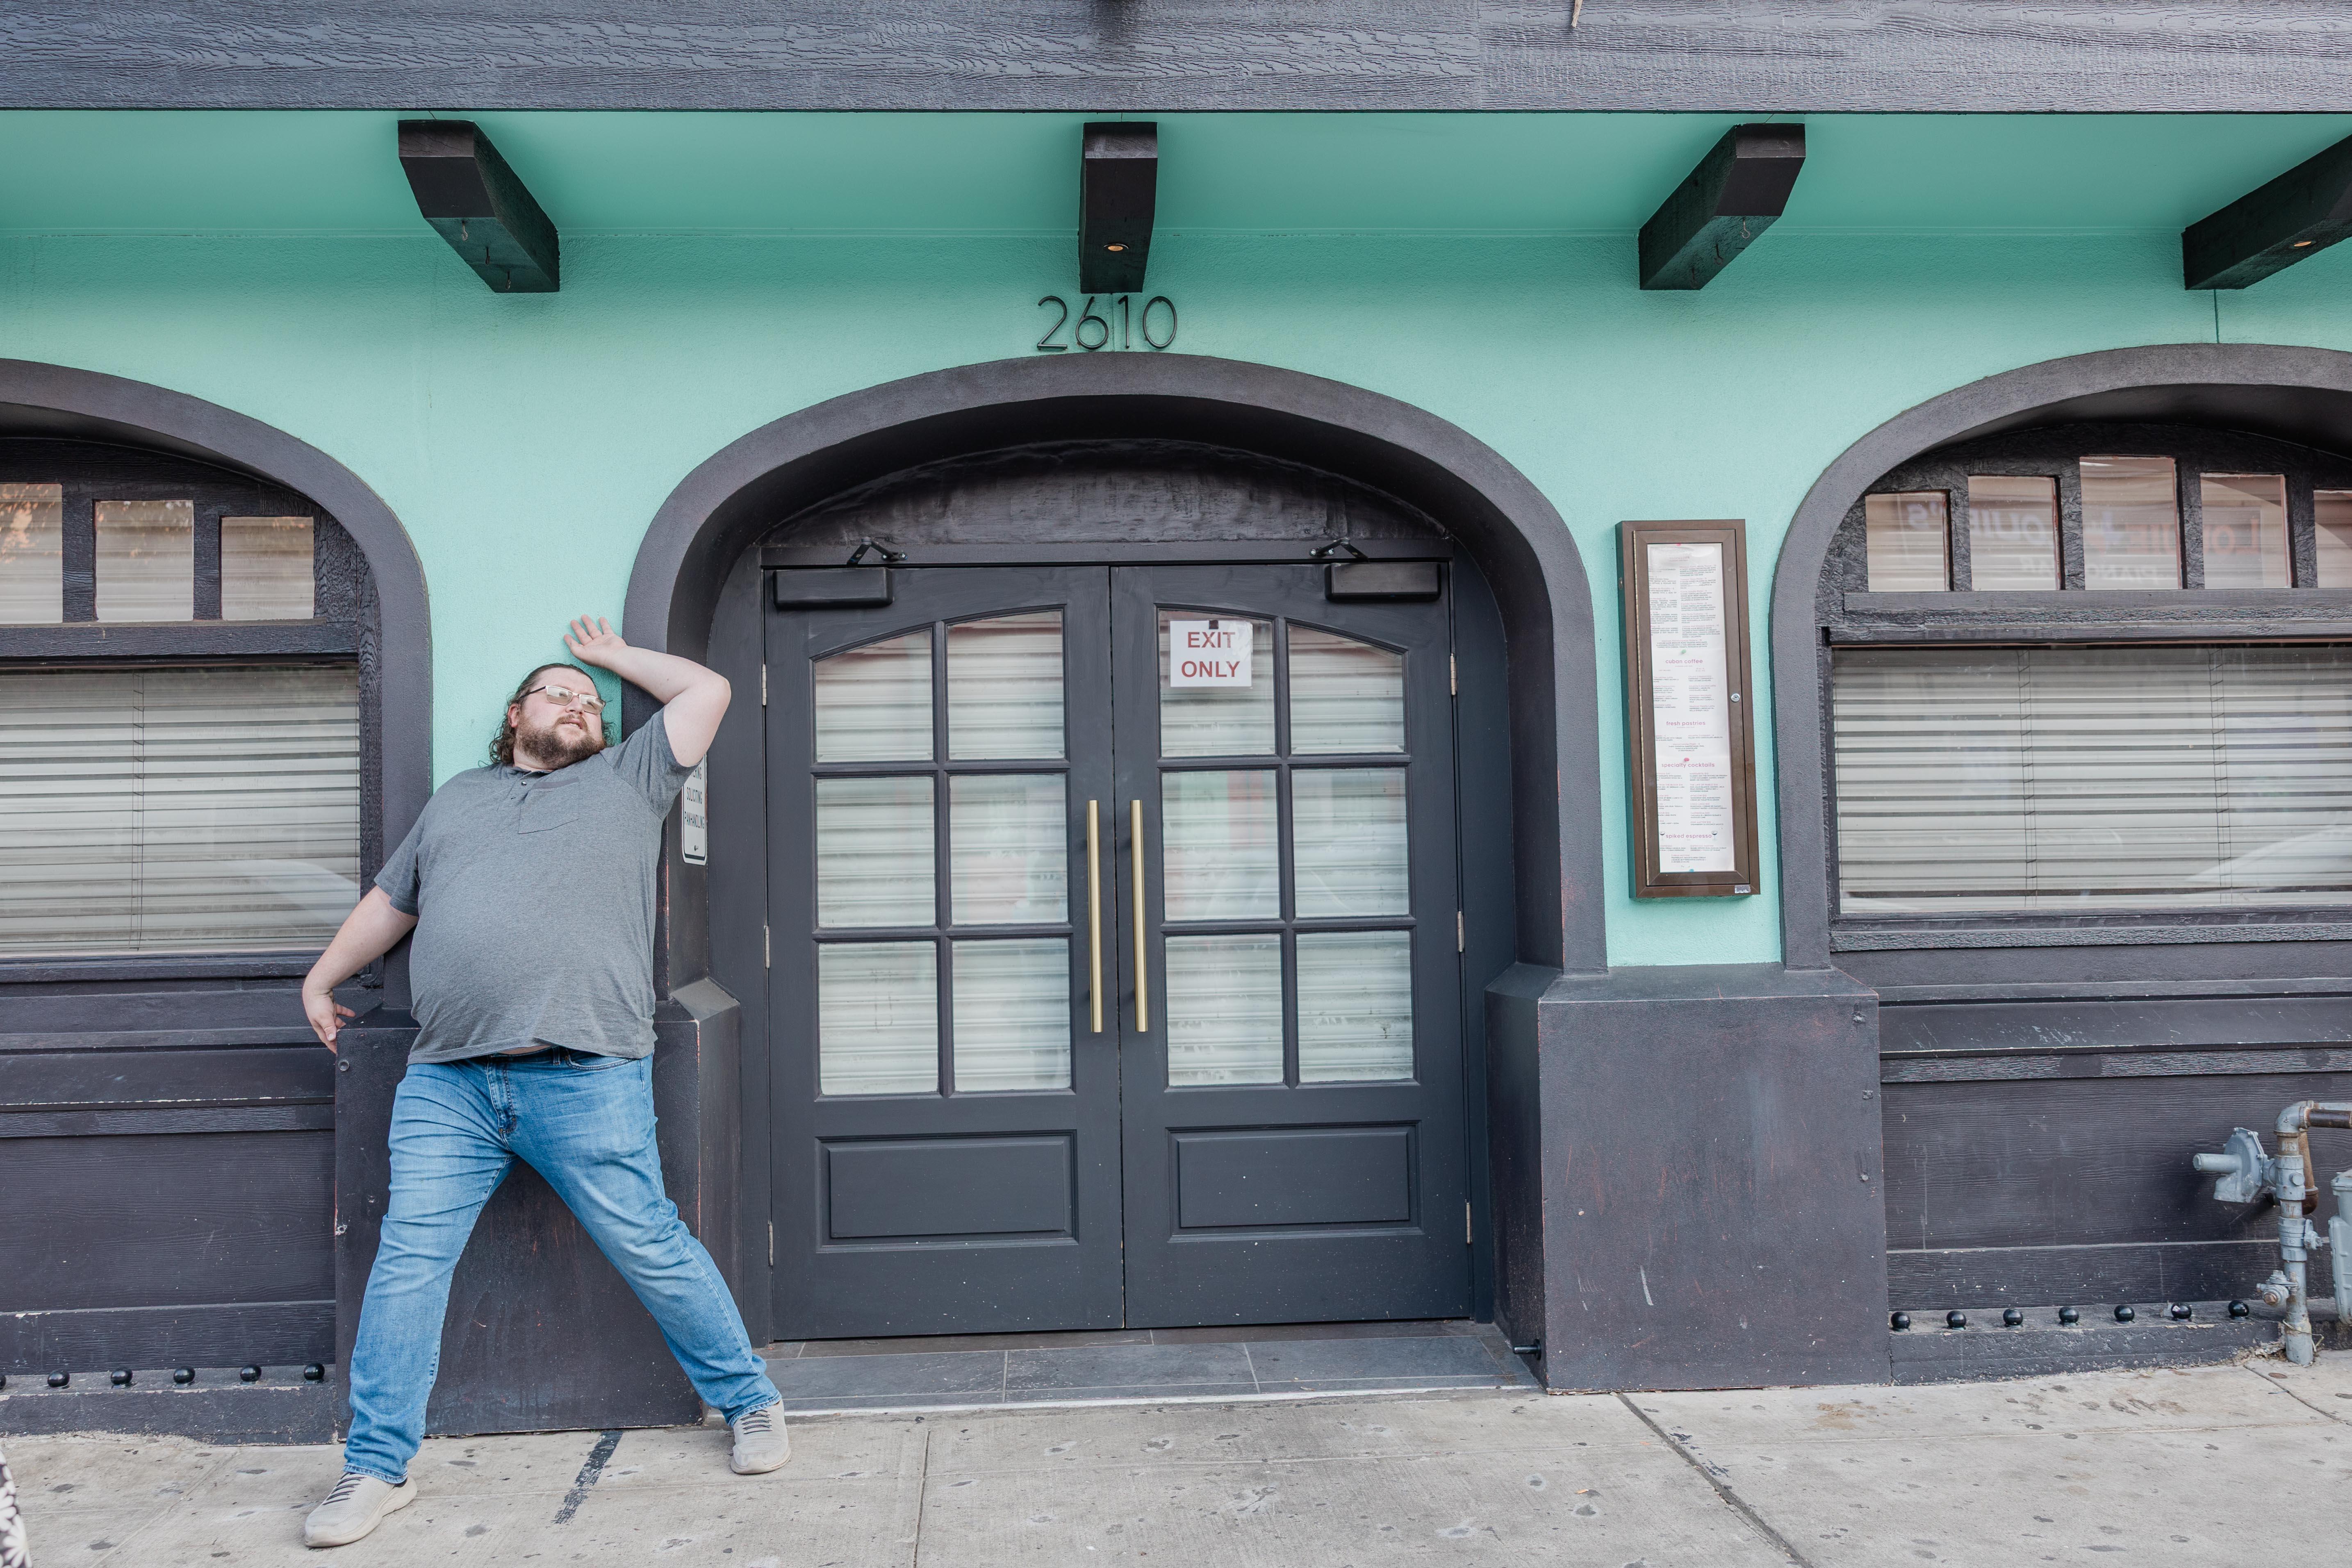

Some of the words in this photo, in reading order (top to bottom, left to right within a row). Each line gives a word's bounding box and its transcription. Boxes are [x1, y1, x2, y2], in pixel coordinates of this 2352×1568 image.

[1036, 295, 1177, 350] 2610
[1187, 632, 1236, 648] EXIT
[1181, 661, 1240, 678] ONLY
[686, 787, 703, 804] SOLICITING
[684, 811, 704, 829] PANHANDLING
